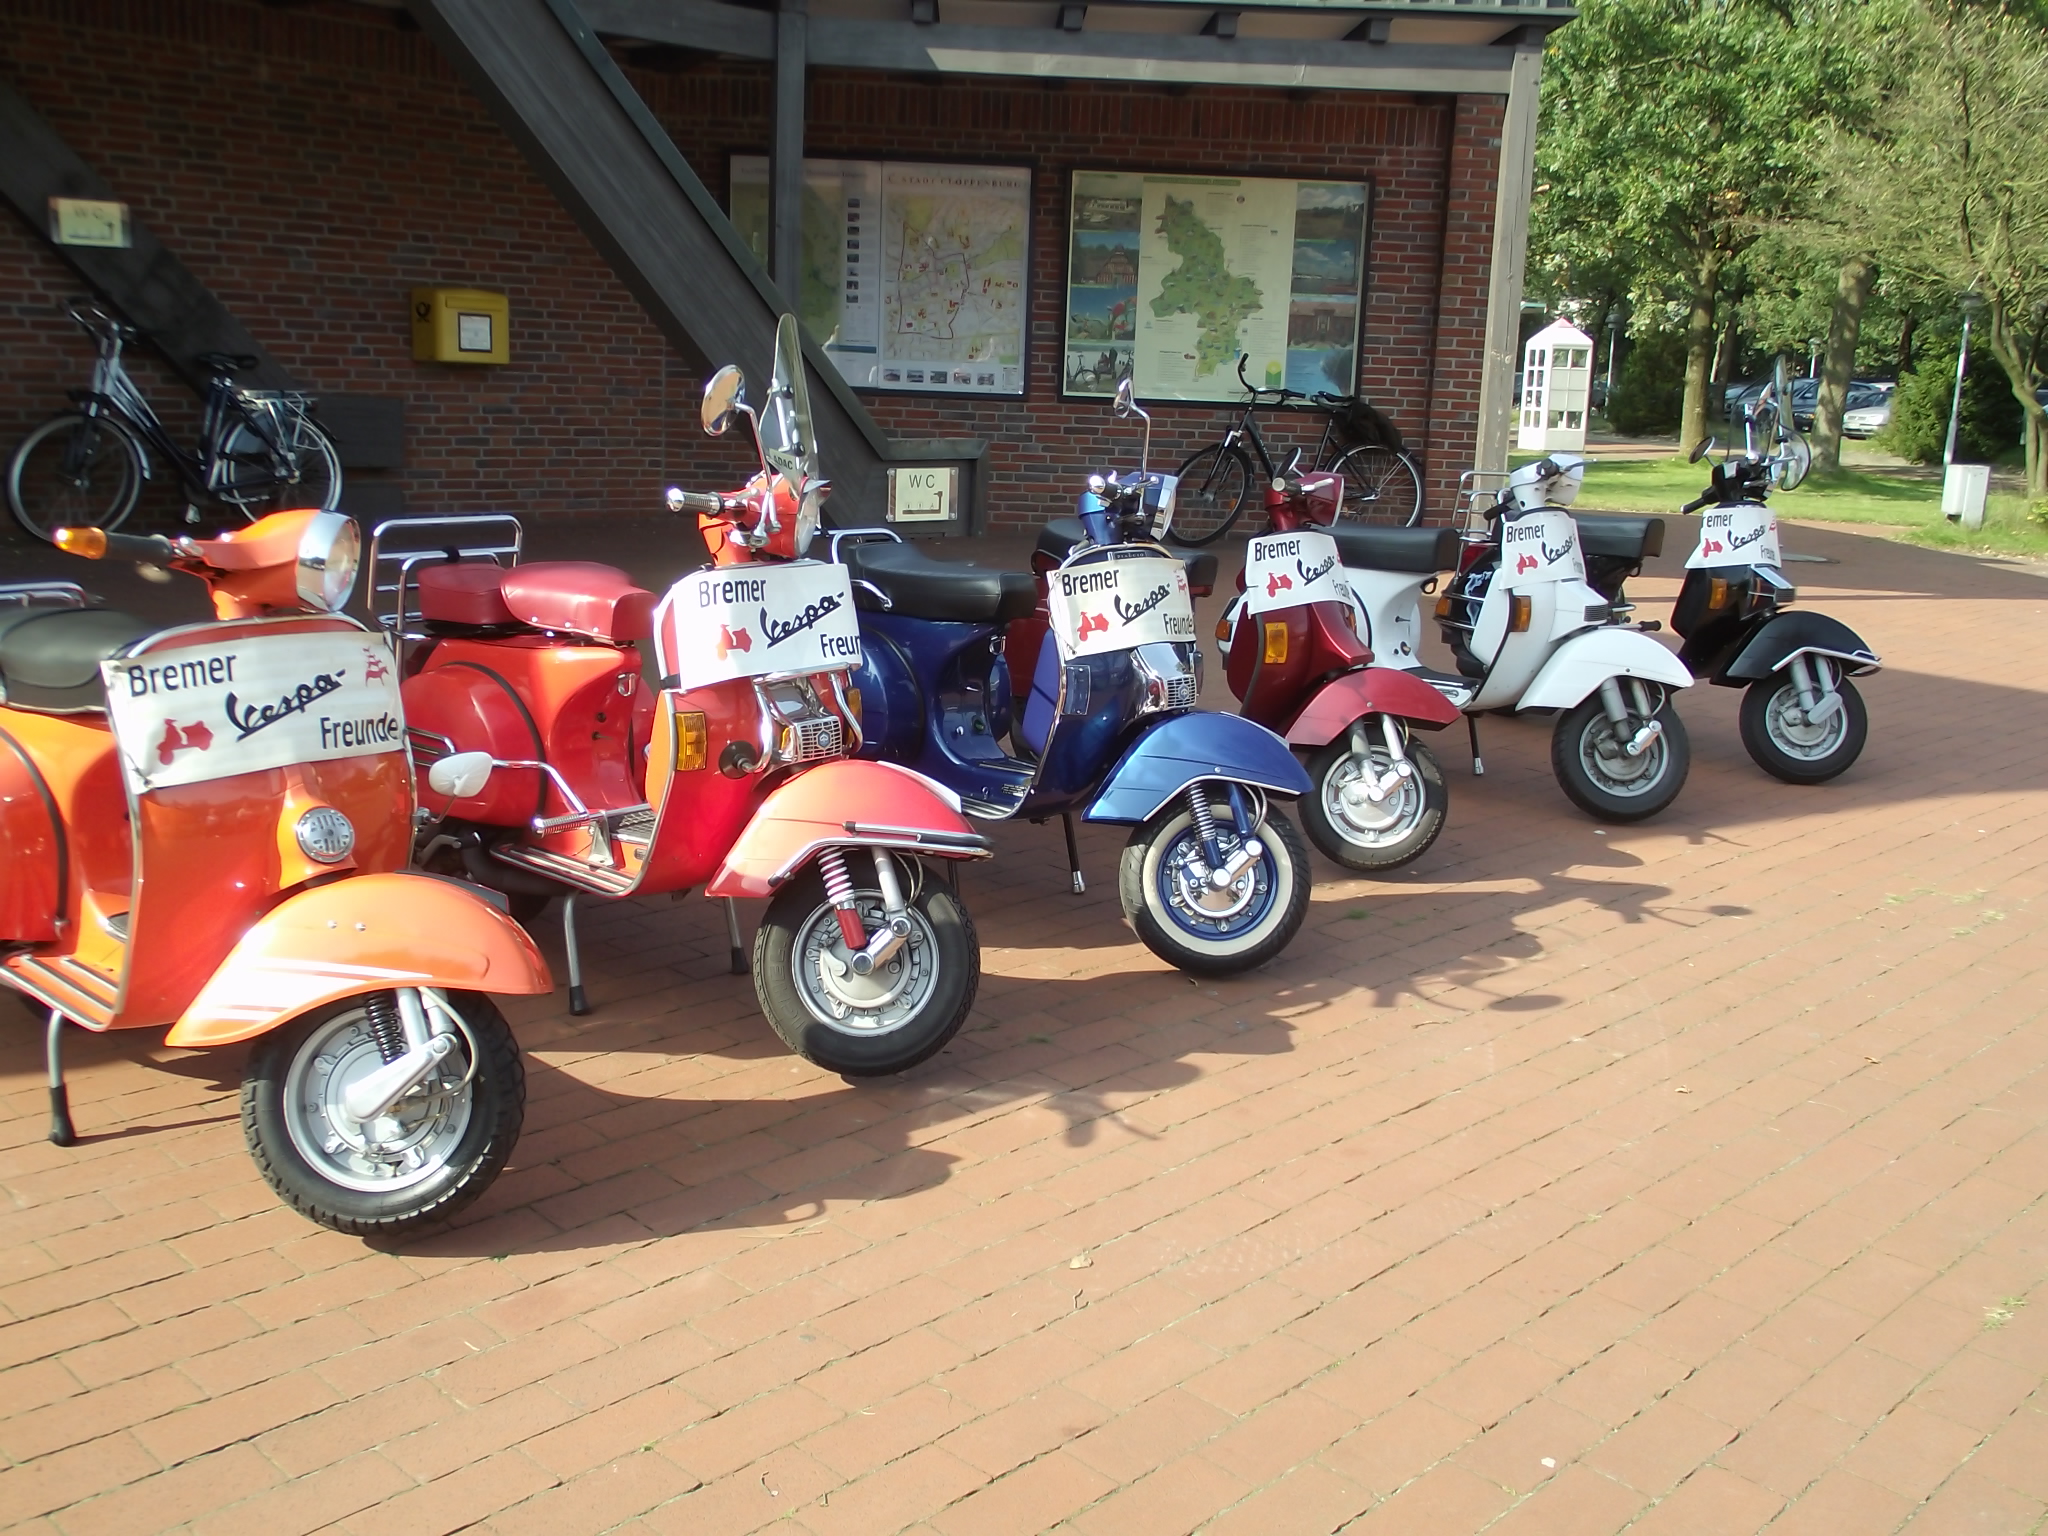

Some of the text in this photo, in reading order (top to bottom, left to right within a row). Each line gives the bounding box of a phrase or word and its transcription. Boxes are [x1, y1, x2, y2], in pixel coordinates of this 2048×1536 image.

[773, 455, 793, 470] ADAC
[909, 474, 935, 489] WC
[1506, 524, 1545, 543] Bremer
[1727, 524, 1766, 551] Vespa
[1254, 539, 1301, 562] Bremer
[1061, 569, 1120, 597] Bremer
[1296, 554, 1335, 587] Vespa
[698, 579, 767, 608] Bremer
[1113, 583, 1171, 627] Vespa
[759, 591, 844, 650] Vespa
[129, 653, 237, 697] Bremer
[225, 668, 346, 742] Vespa
[320, 711, 399, 749] Freunde
